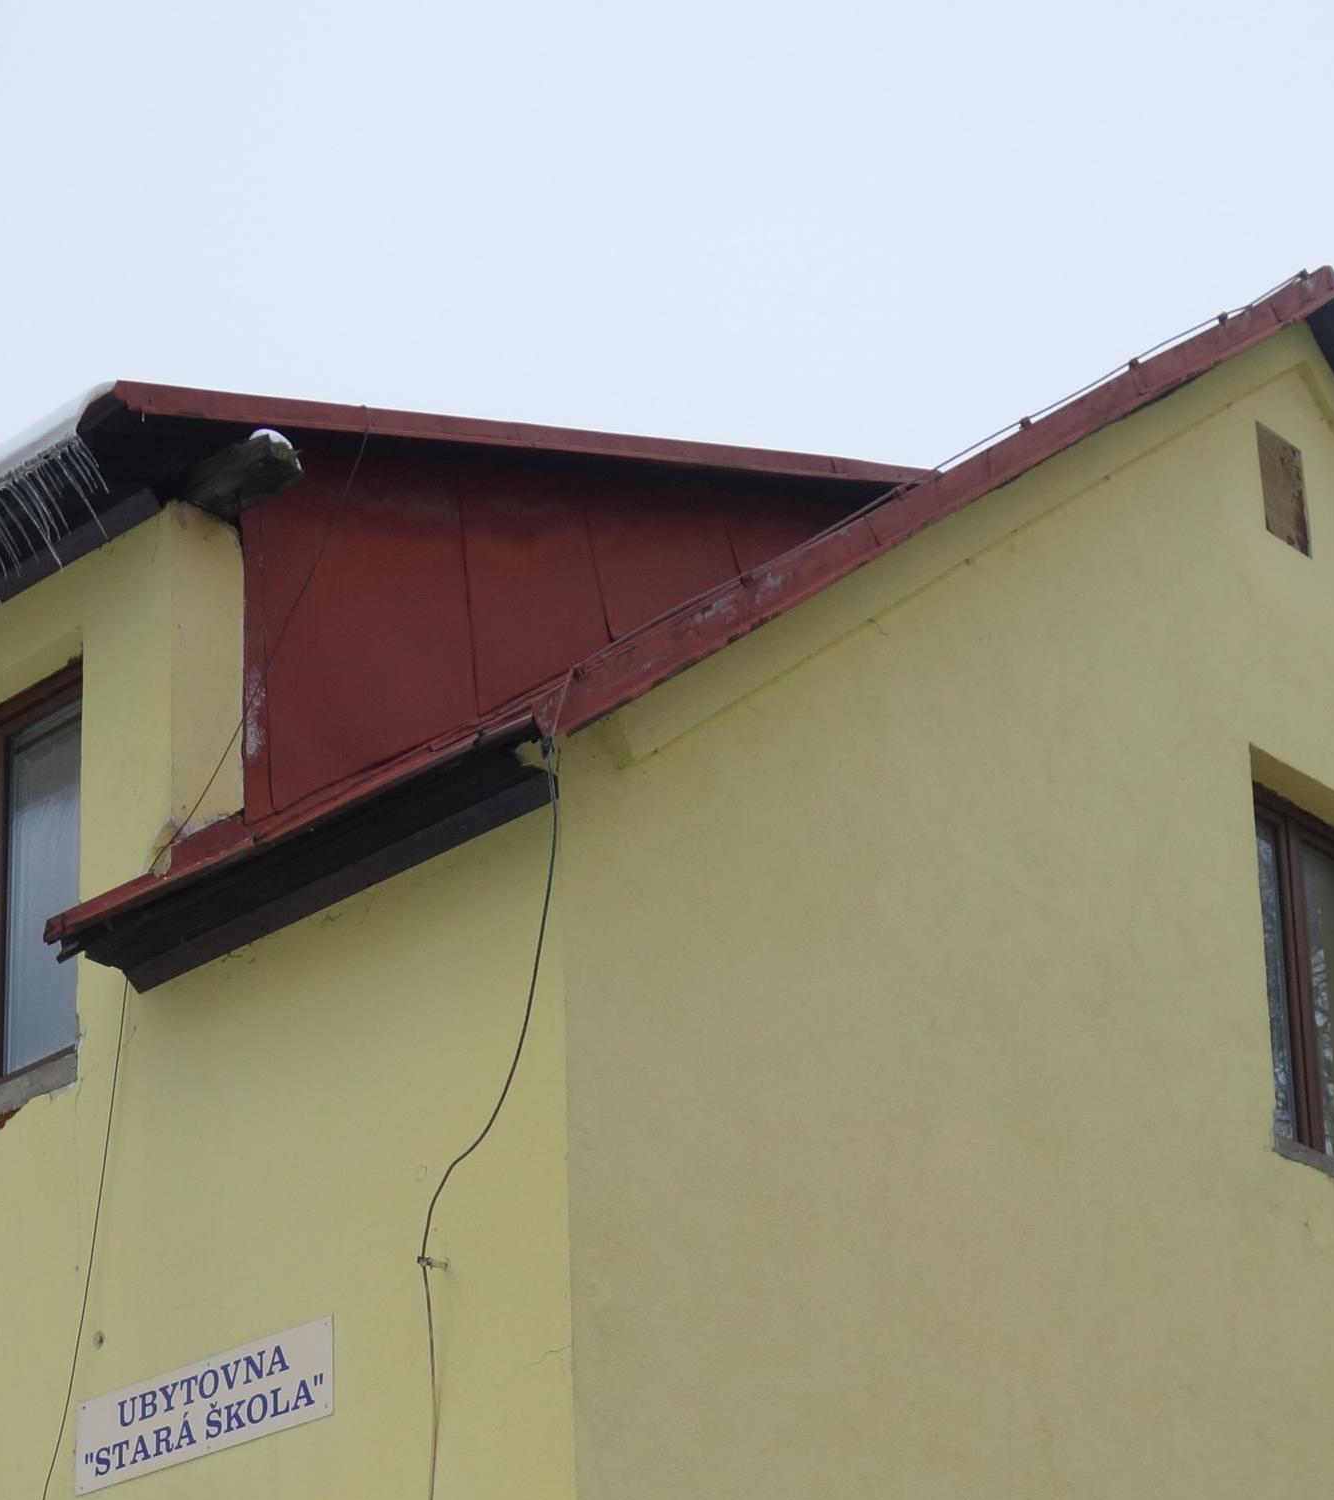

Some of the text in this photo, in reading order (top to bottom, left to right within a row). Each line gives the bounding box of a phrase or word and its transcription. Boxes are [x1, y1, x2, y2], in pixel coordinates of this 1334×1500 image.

[84, 1373, 325, 1477] "STARÁ ŠKOLA"
[117, 1345, 290, 1428] UBYTOVNA
